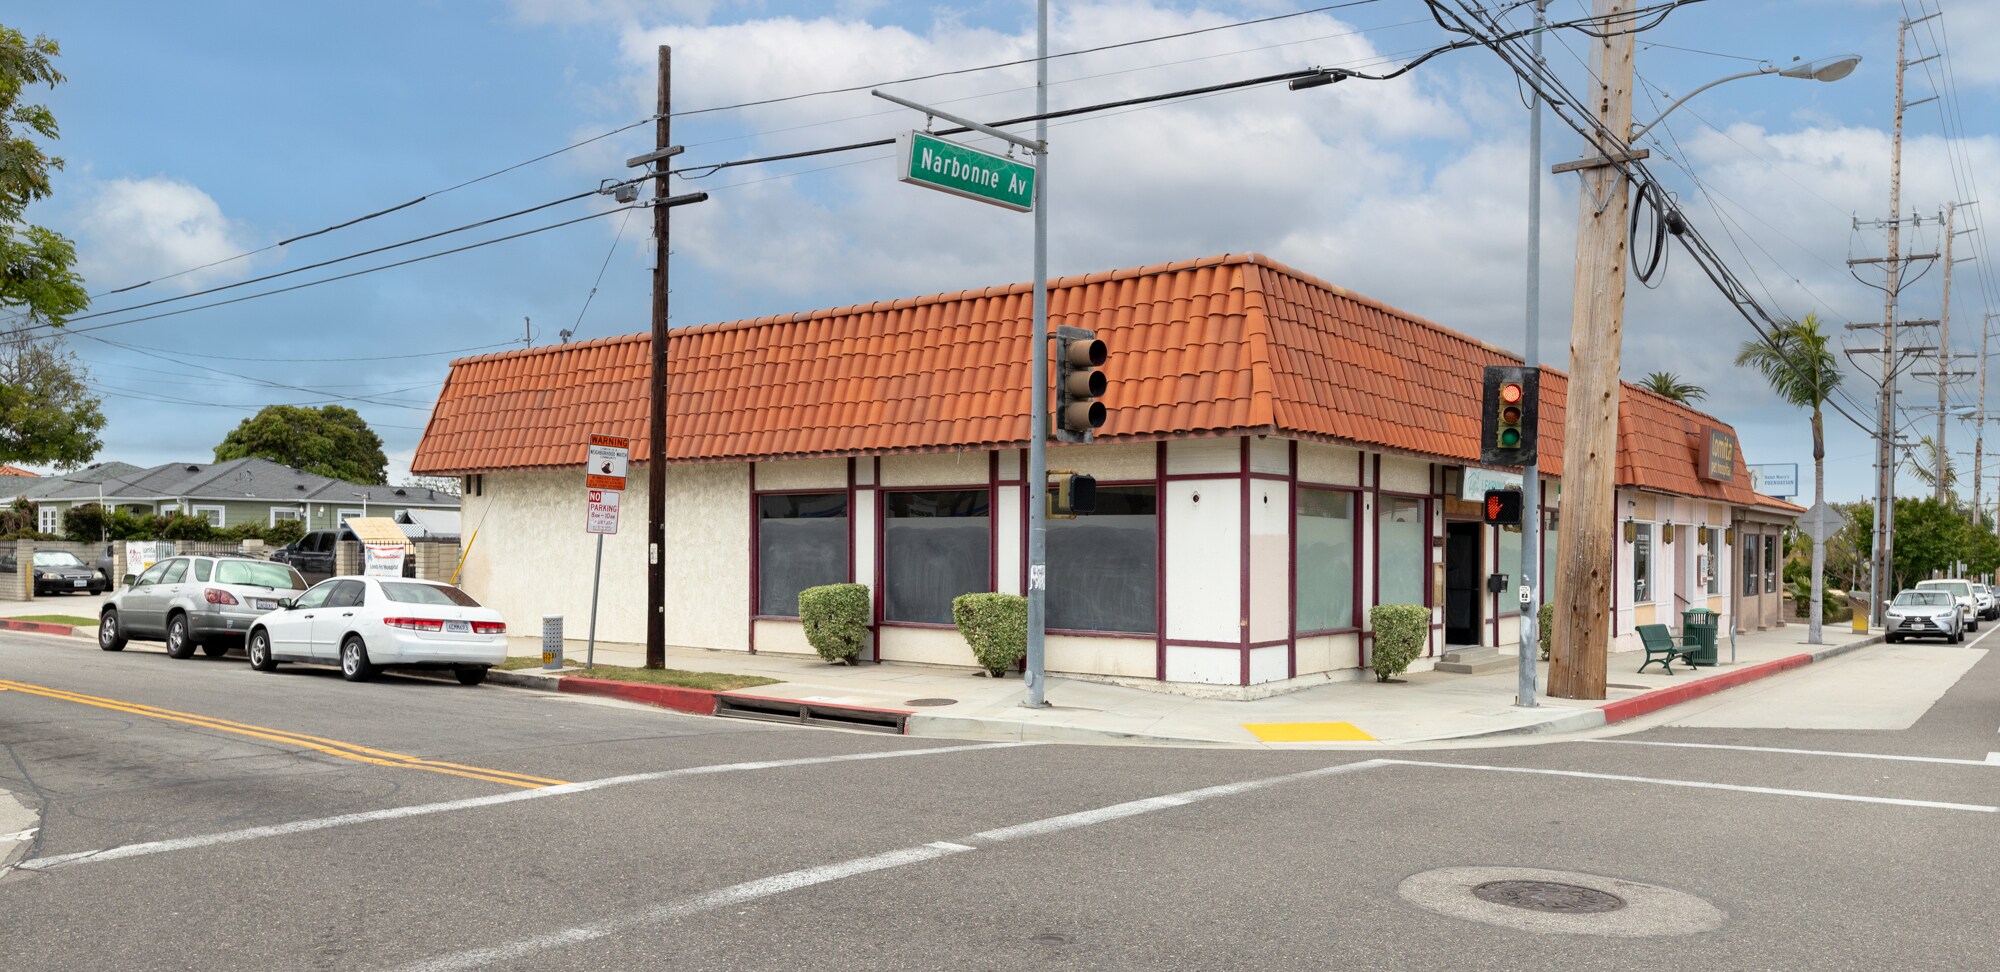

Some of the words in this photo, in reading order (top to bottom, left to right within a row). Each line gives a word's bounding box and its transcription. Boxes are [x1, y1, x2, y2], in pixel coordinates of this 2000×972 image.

[921, 147, 999, 189] Narbonne
[1008, 172, 1027, 195] Av
[591, 436, 628, 447] WARNING
[590, 449, 616, 457] NEIGHBORHOOD
[590, 492, 601, 502] NO
[590, 503, 617, 513] PARKING
